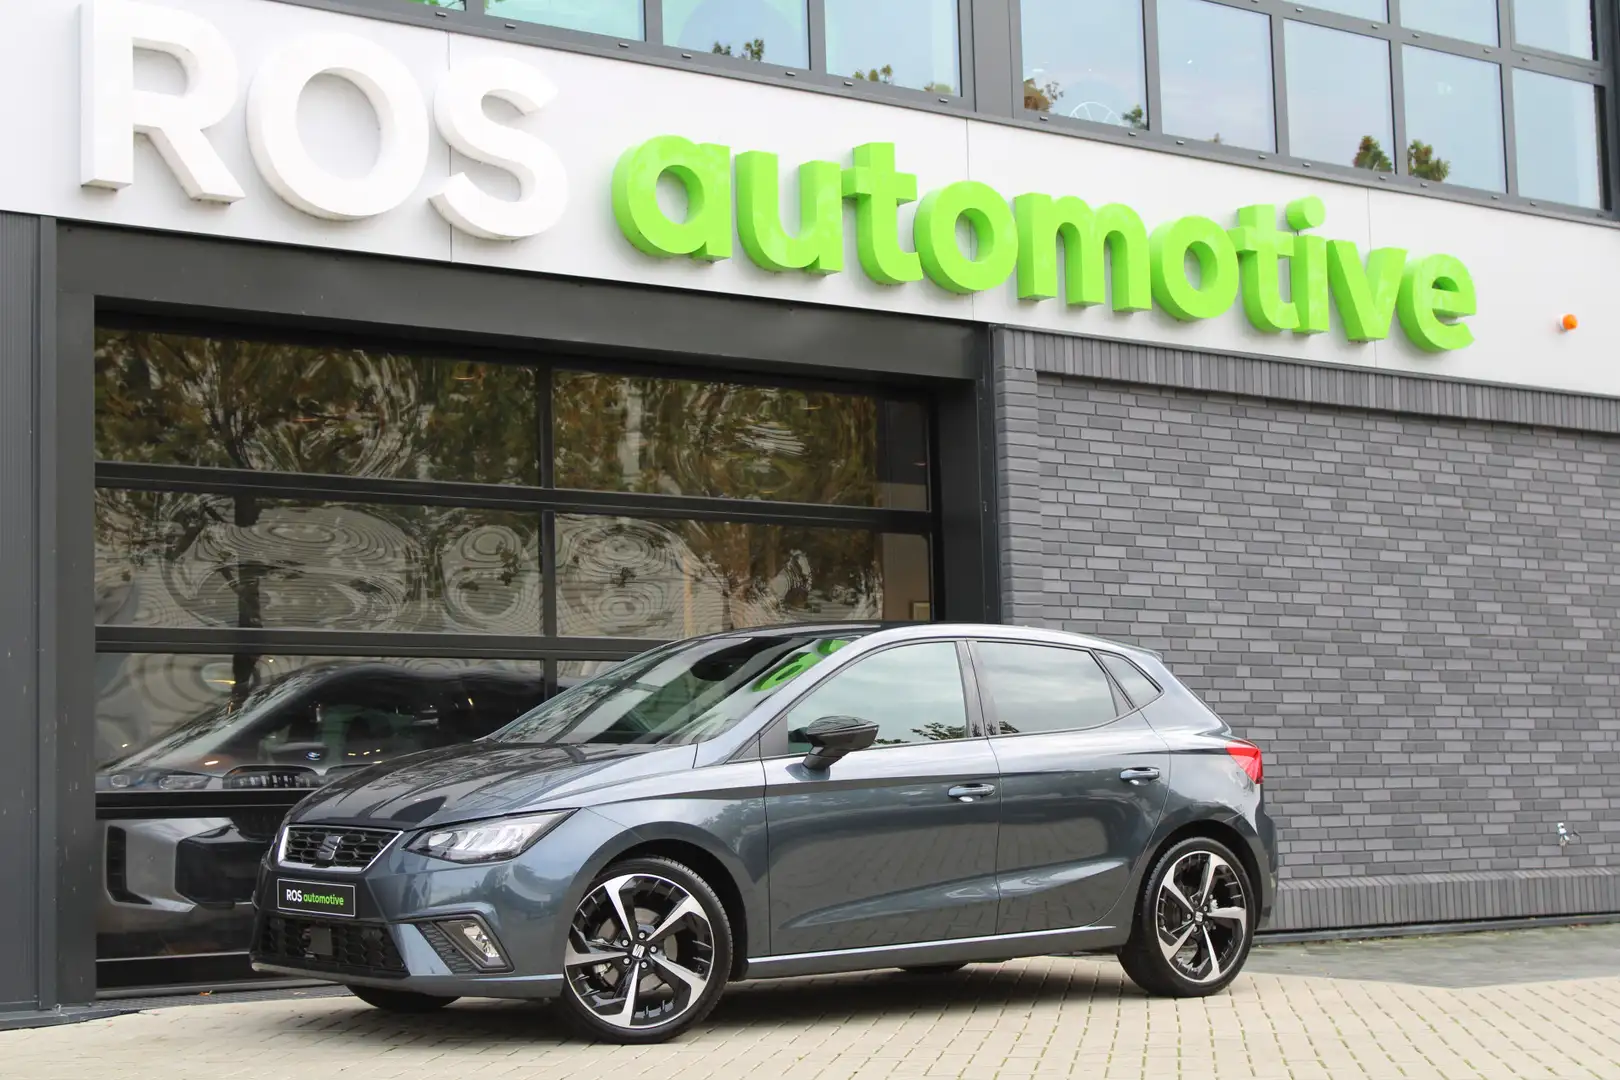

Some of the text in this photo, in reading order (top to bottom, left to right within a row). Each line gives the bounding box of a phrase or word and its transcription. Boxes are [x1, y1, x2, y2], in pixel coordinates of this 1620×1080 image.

[79, 0, 1477, 352] ROS automotive
[286, 889, 344, 905] ROS automotive
